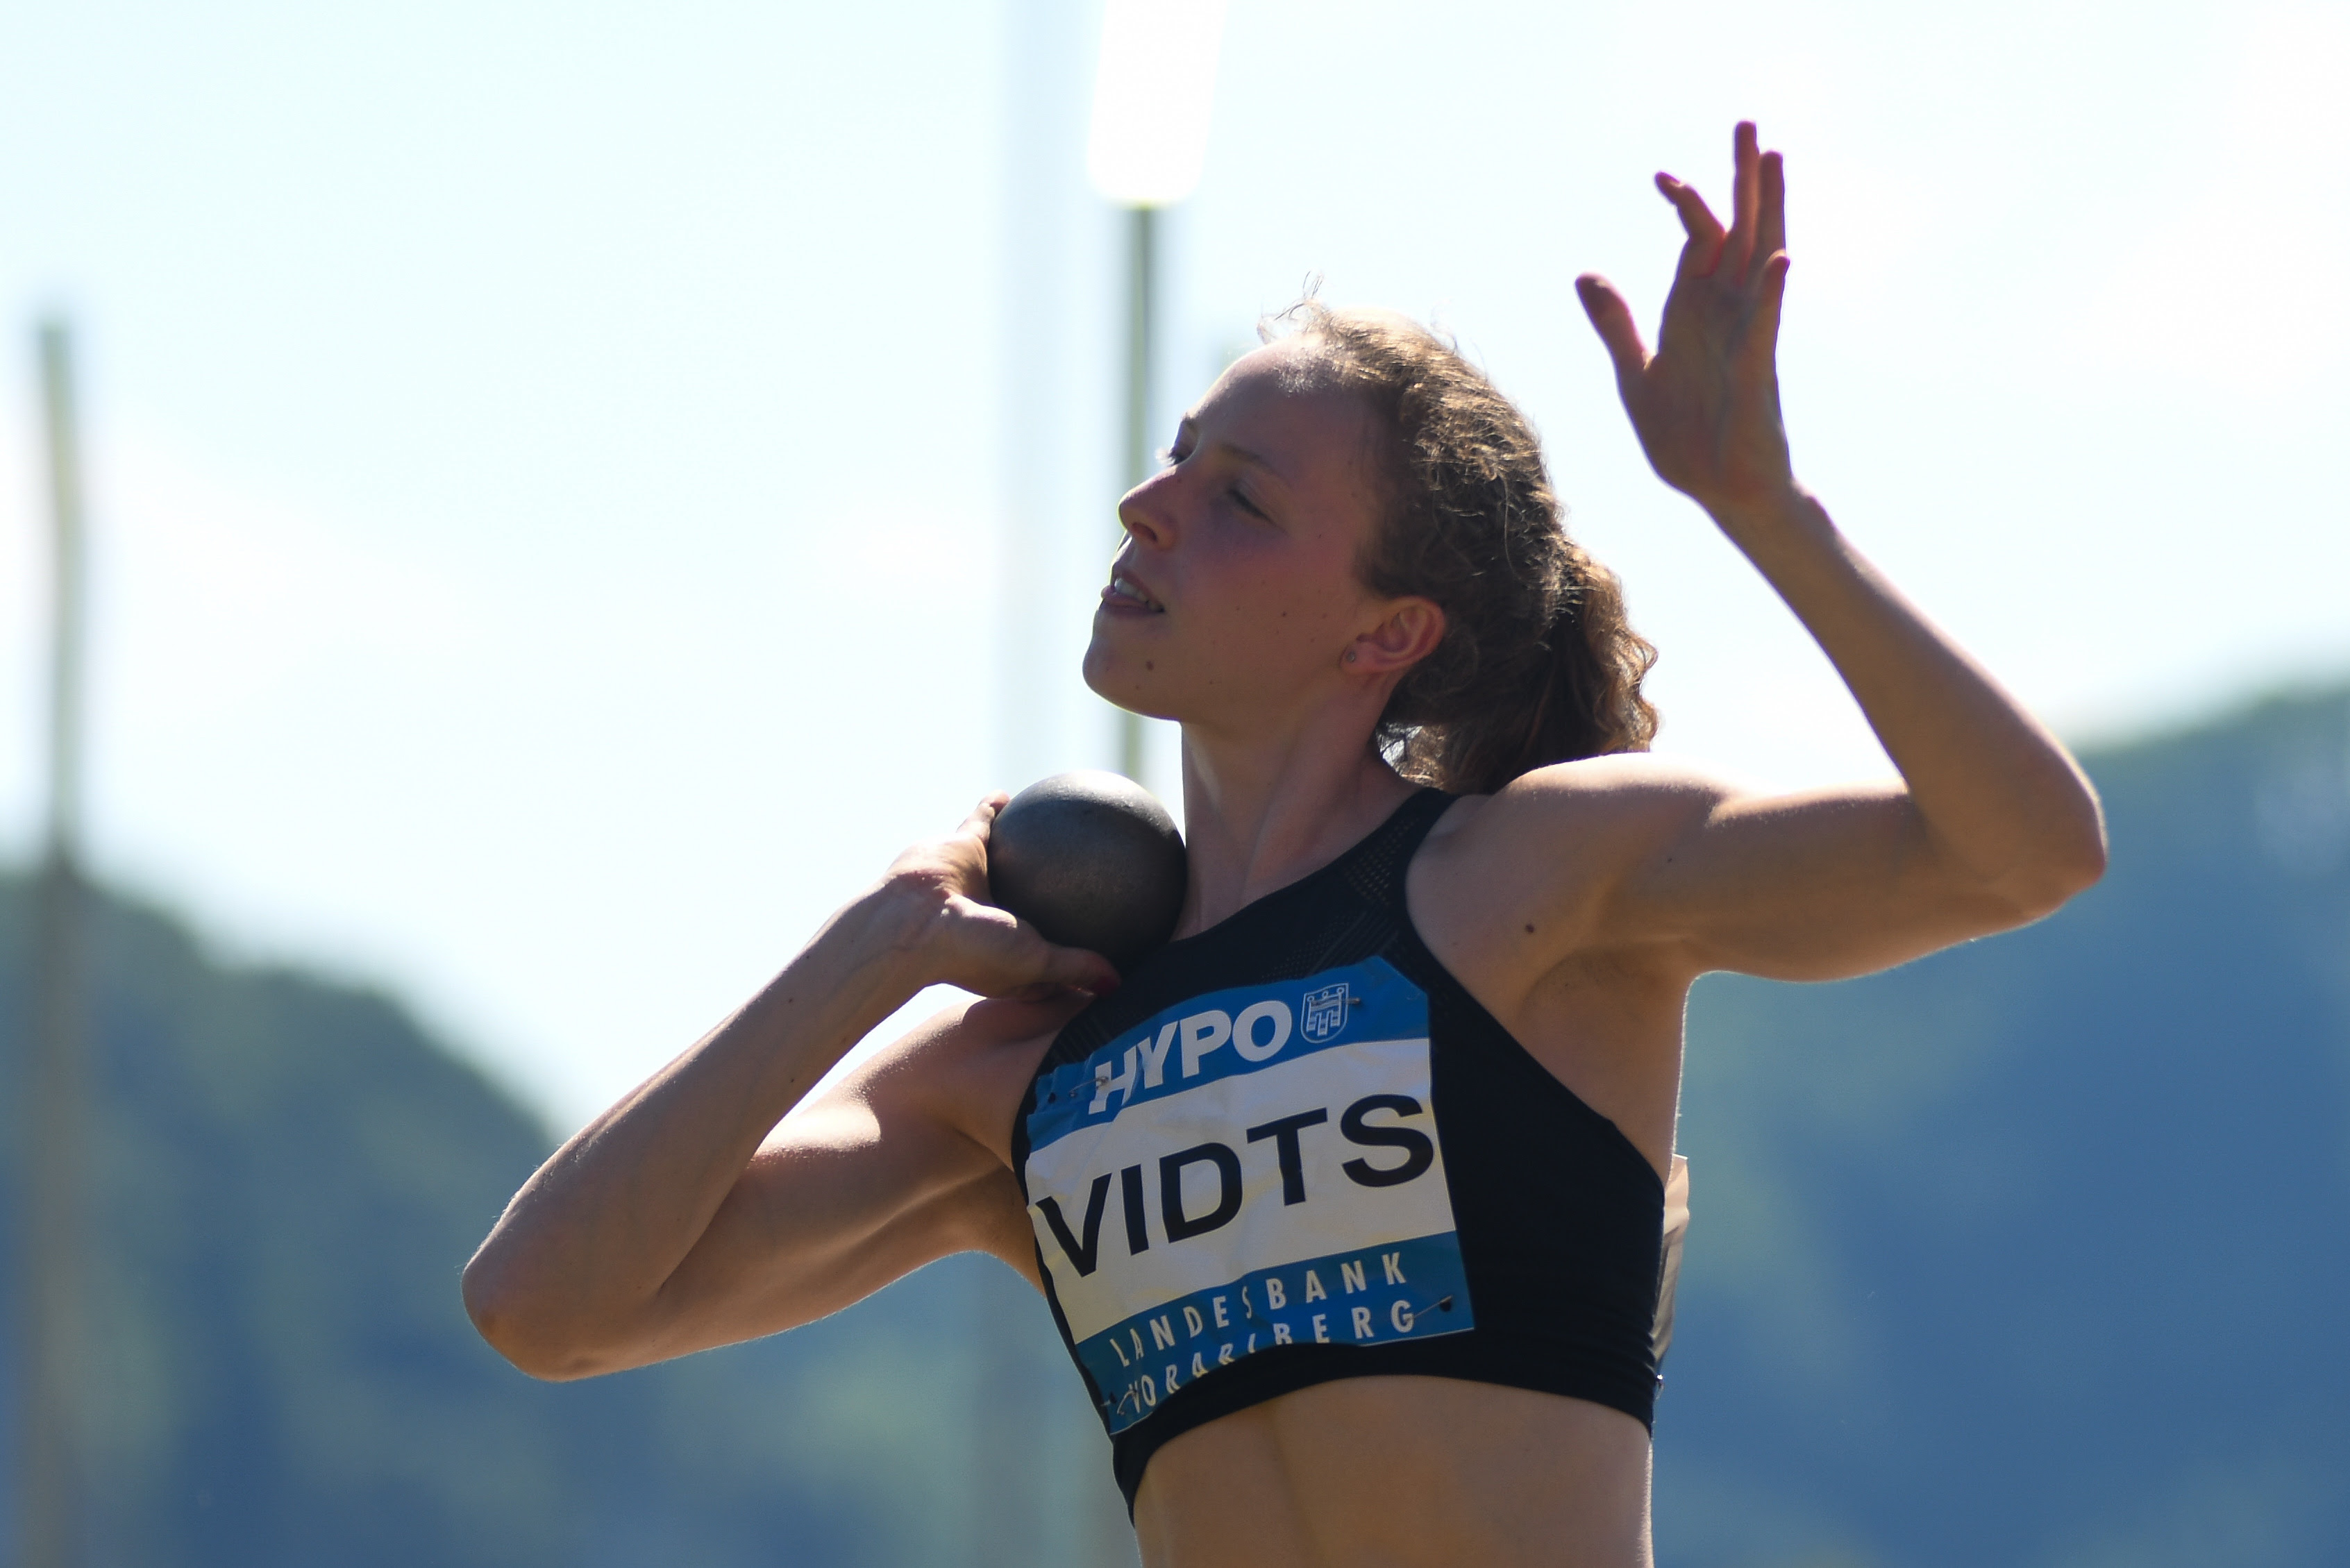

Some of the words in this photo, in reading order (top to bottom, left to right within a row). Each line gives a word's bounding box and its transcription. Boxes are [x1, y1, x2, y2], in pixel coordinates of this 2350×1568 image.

[1088, 1000, 1292, 1115] HYPO
[1035, 1094, 1434, 1278] VIDTS
[1110, 1251, 1407, 1367] LANDESBANK
